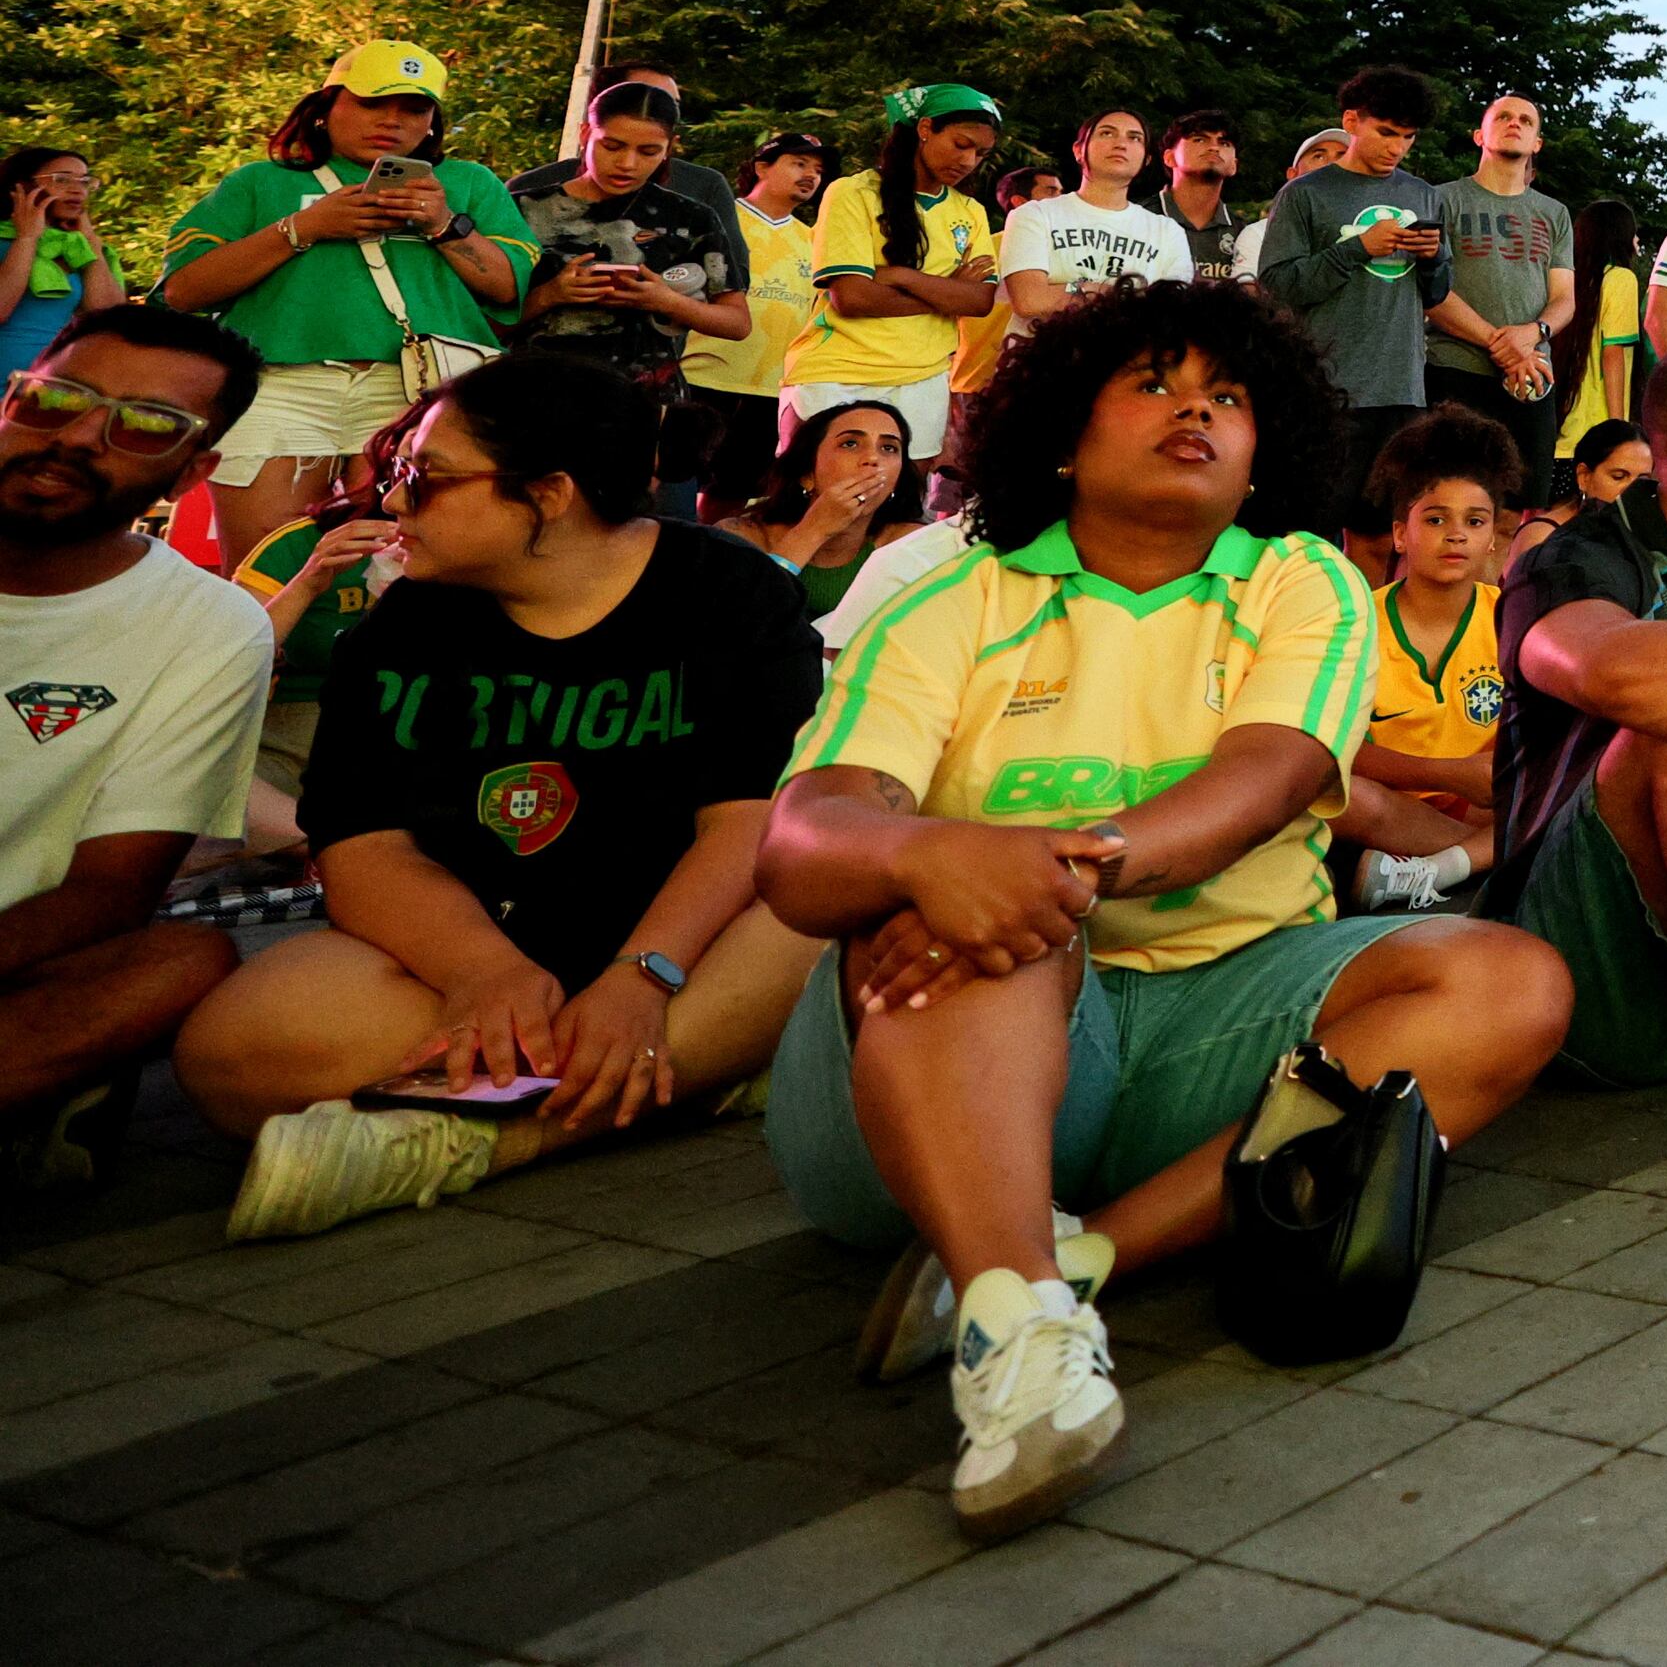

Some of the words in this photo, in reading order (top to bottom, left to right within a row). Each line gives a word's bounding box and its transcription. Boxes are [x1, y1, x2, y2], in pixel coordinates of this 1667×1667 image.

[1051, 228, 1160, 264] GERMANY
[1460, 211, 1551, 263] USA
[1196, 259, 1233, 278] rate
